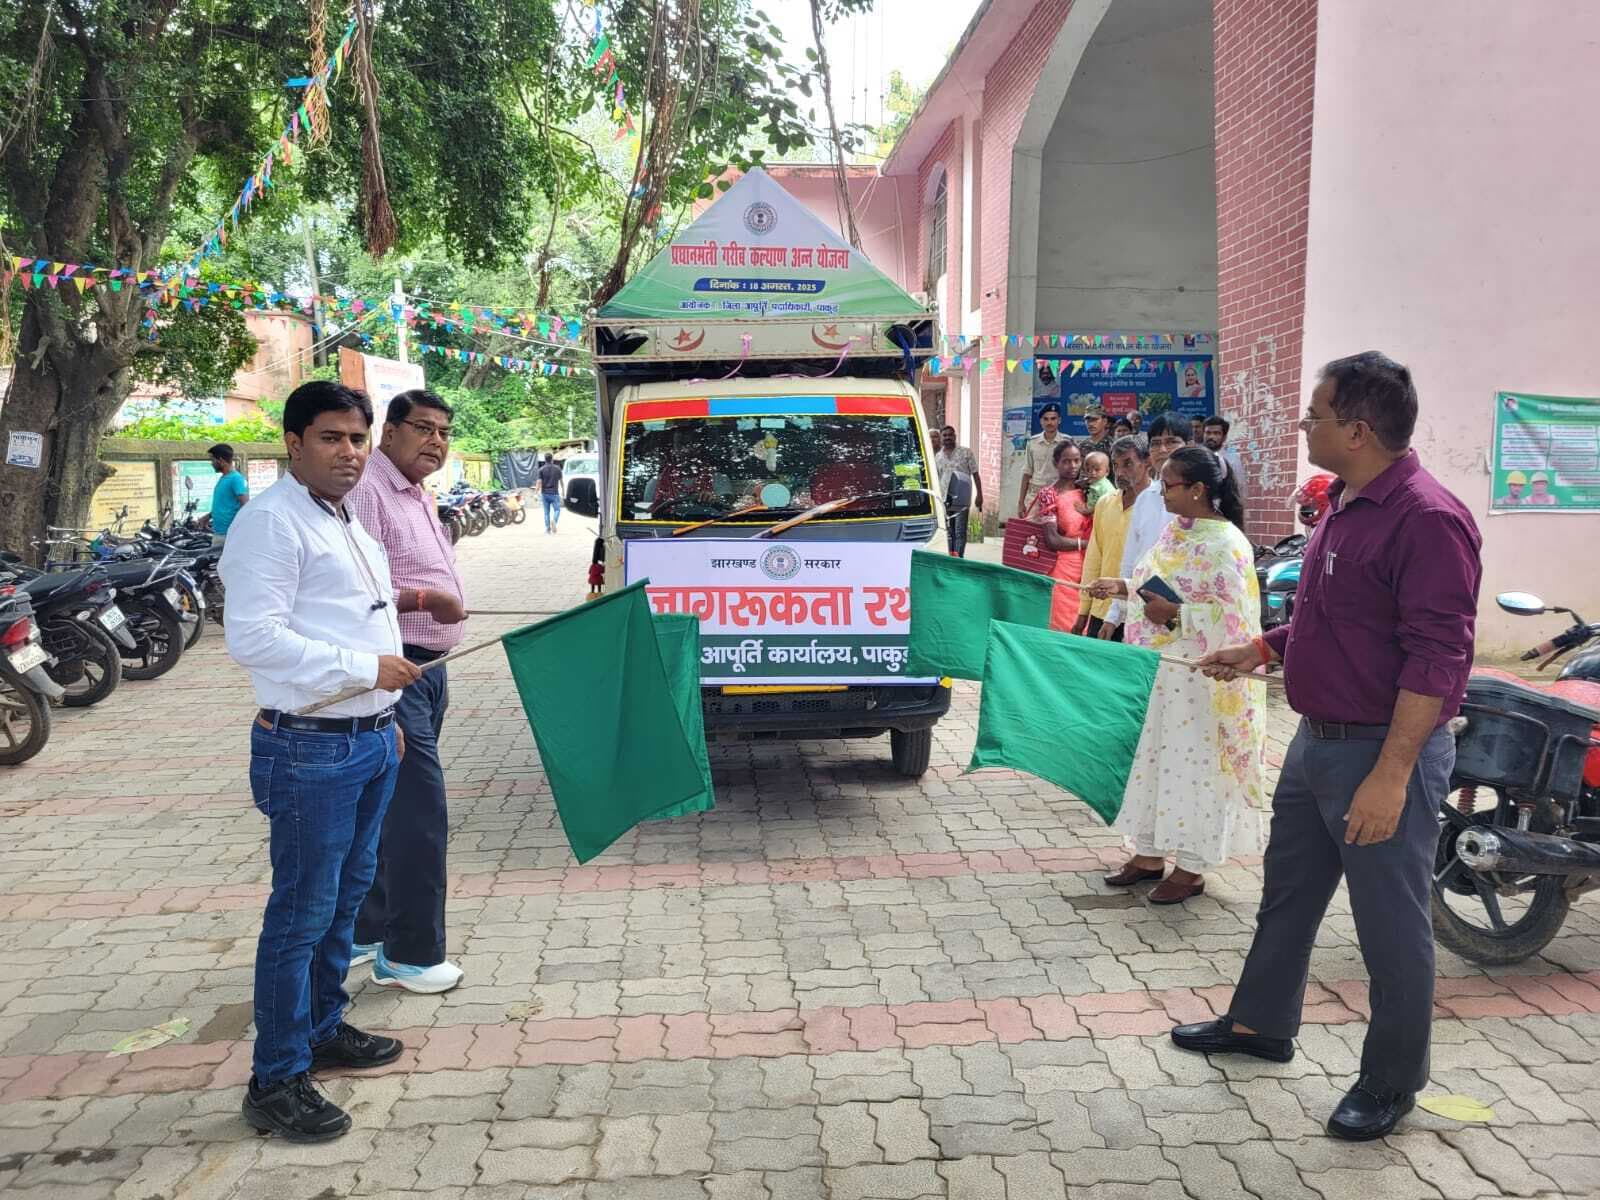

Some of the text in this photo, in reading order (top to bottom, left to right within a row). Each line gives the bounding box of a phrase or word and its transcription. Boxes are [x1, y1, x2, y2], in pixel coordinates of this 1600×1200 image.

[671, 240, 849, 269] प्रधानमंत्री गरीब कल्याण अन्न योजना
[710, 278, 739, 289] दिनांक
[750, 282, 758, 290] 18
[797, 283, 817, 291] 2025
[711, 558, 842, 569] झारखण्ड सरकार
[700, 640, 763, 673] आपूर्ति
[768, 640, 858, 666] कार्यालय,
